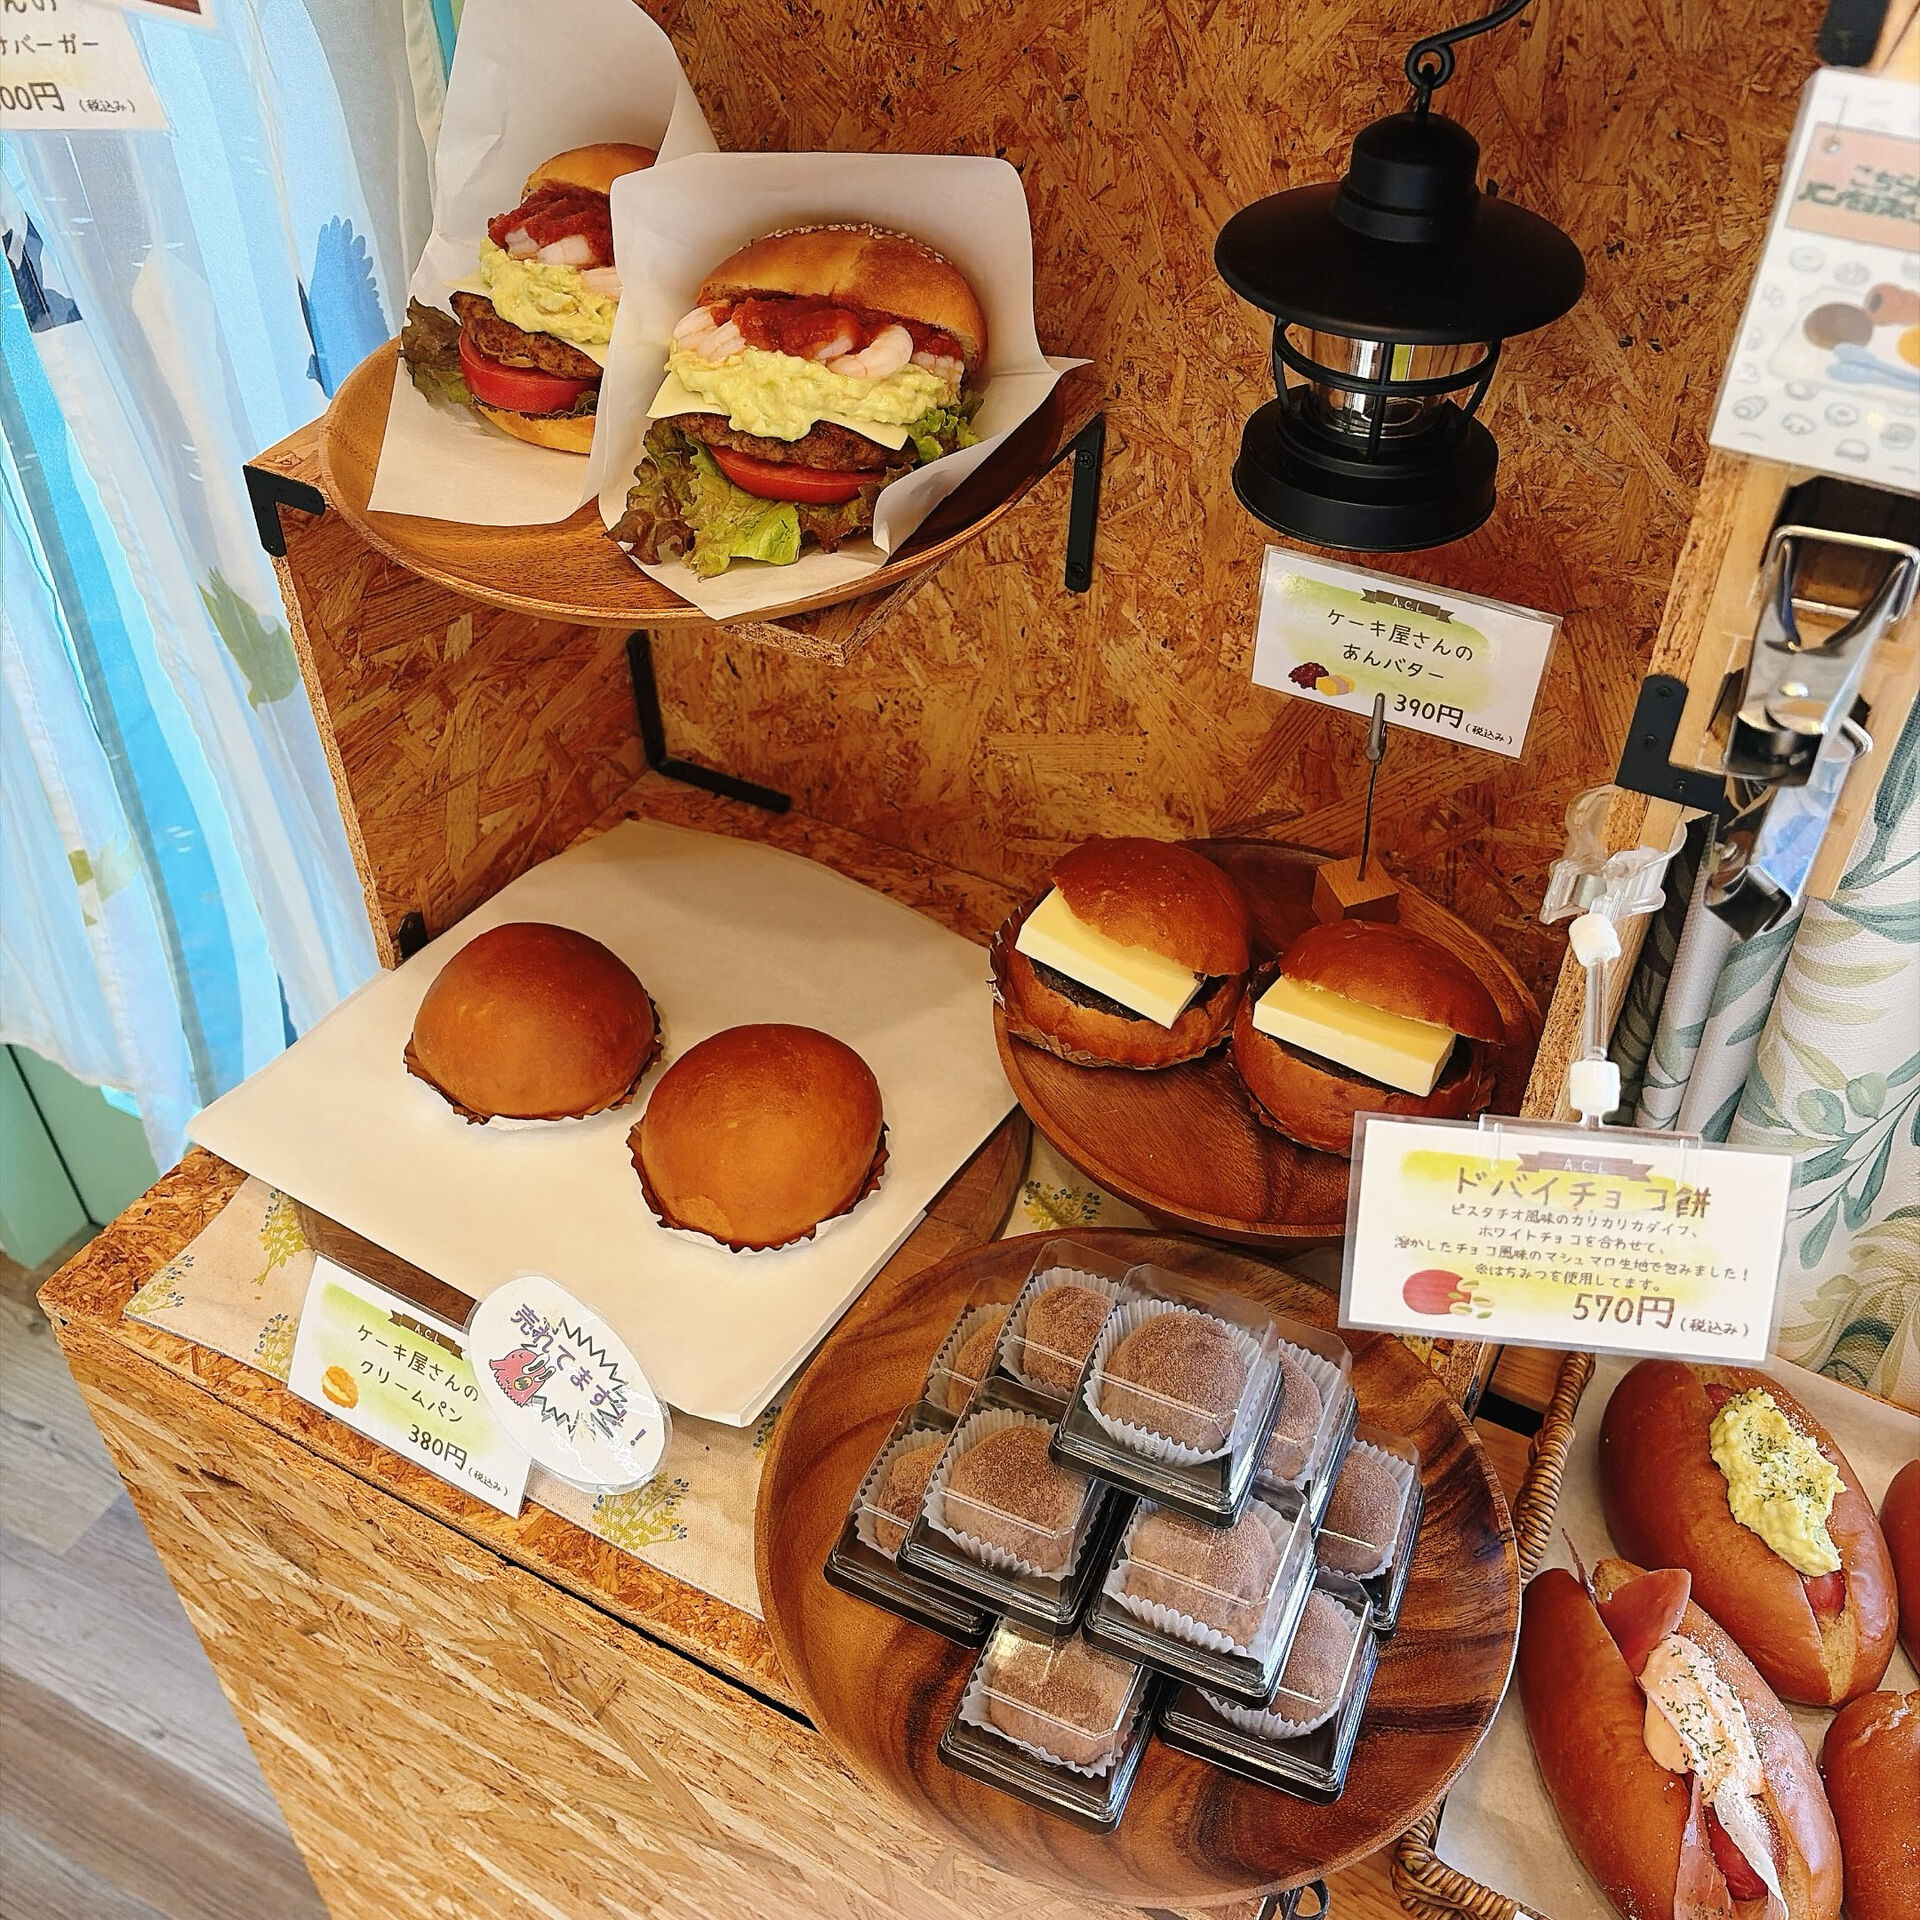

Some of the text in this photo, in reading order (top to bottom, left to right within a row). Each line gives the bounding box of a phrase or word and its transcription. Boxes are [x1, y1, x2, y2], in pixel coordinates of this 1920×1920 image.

[0, 81, 65, 112] 00円
[1392, 597, 1423, 613] A.C.L
[1328, 609, 1473, 661] ケーキ屋さんの
[1343, 643, 1444, 679] あんバター
[1394, 694, 1513, 745] 390円 (税込み)
[1457, 1166, 1712, 1219] ドバイチョコ餅
[1451, 1203, 1697, 1238] ピスタチオ風味のカリカリカダイフ、
[1478, 1225, 1664, 1254] ホワイトチョコを合わせて、
[414, 1323, 440, 1345] A.C.L
[1573, 1293, 1749, 1337] 570円 (税込み)
[358, 1325, 479, 1401] ケーキ屋さんの
[360, 1361, 463, 1422] クリームパン
[408, 1424, 509, 1497] 380円 (税込み)
